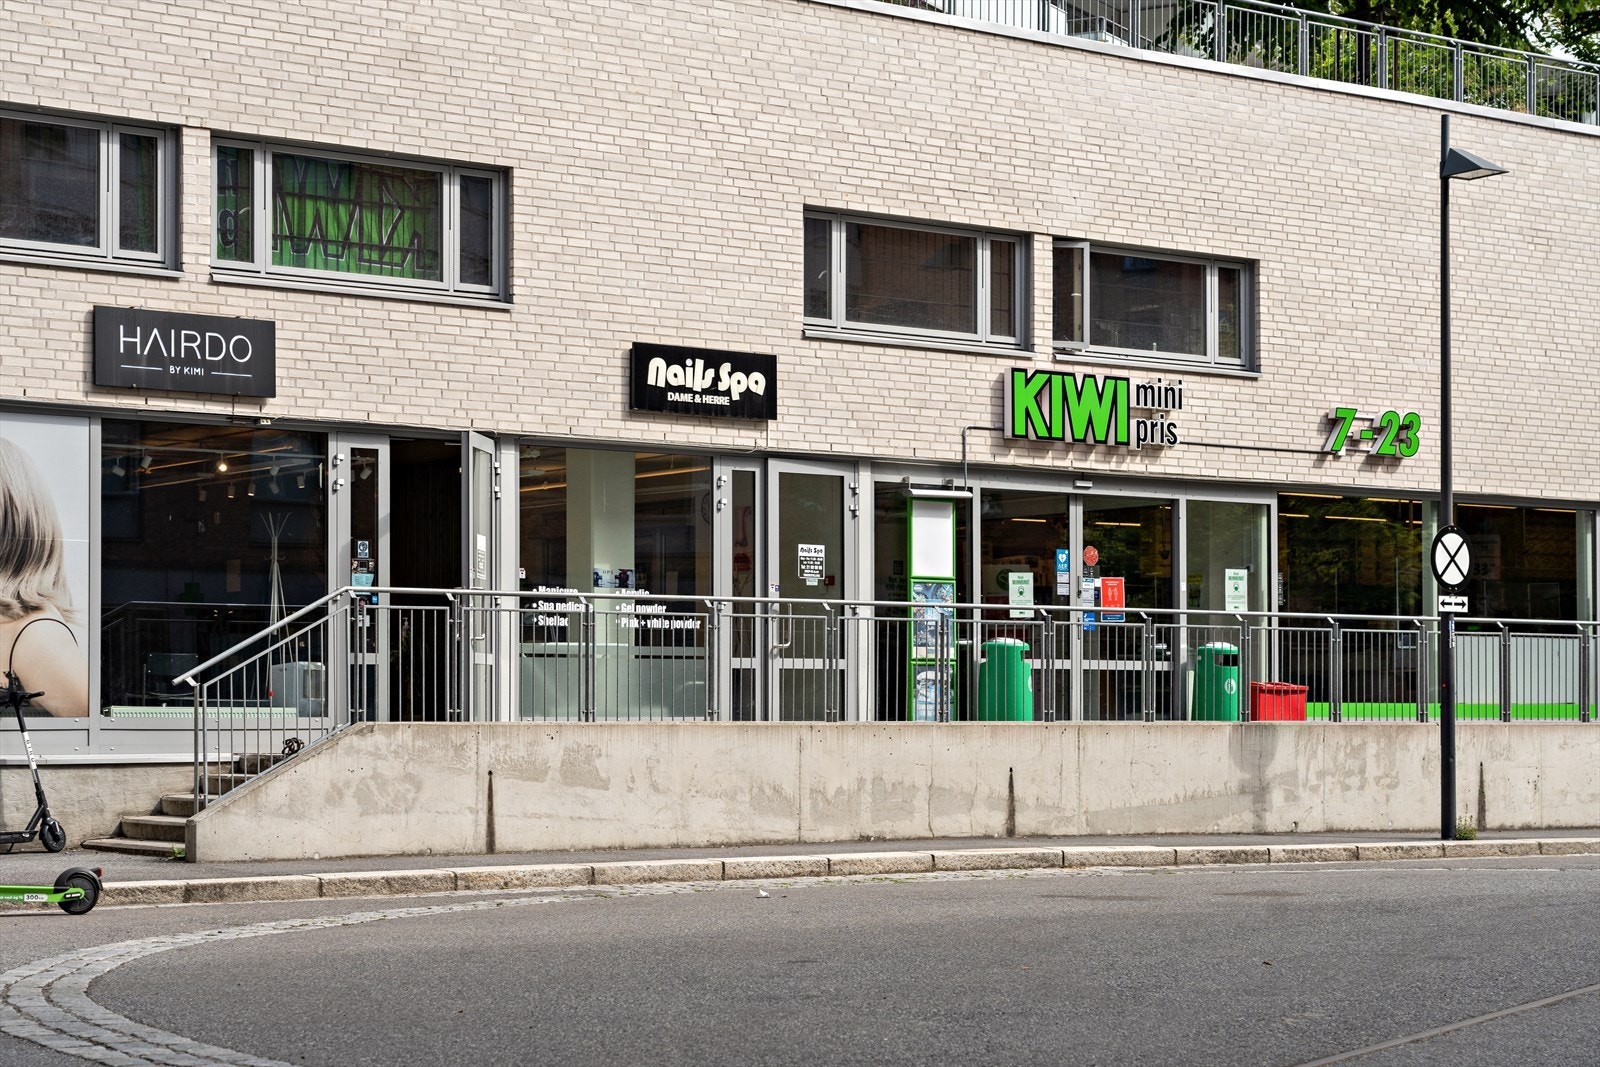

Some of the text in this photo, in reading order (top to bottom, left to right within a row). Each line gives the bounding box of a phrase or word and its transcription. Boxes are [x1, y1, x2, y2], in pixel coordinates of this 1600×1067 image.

[119, 325, 252, 363] HAIRDO
[169, 365, 204, 376] BY KIMI
[718, 362, 766, 401] Spa
[667, 392, 730, 406] DAME & HERRE
[1010, 368, 1182, 446] KIWI mini
[1136, 414, 1178, 449] pris
[621, 618, 639, 628] Pink
